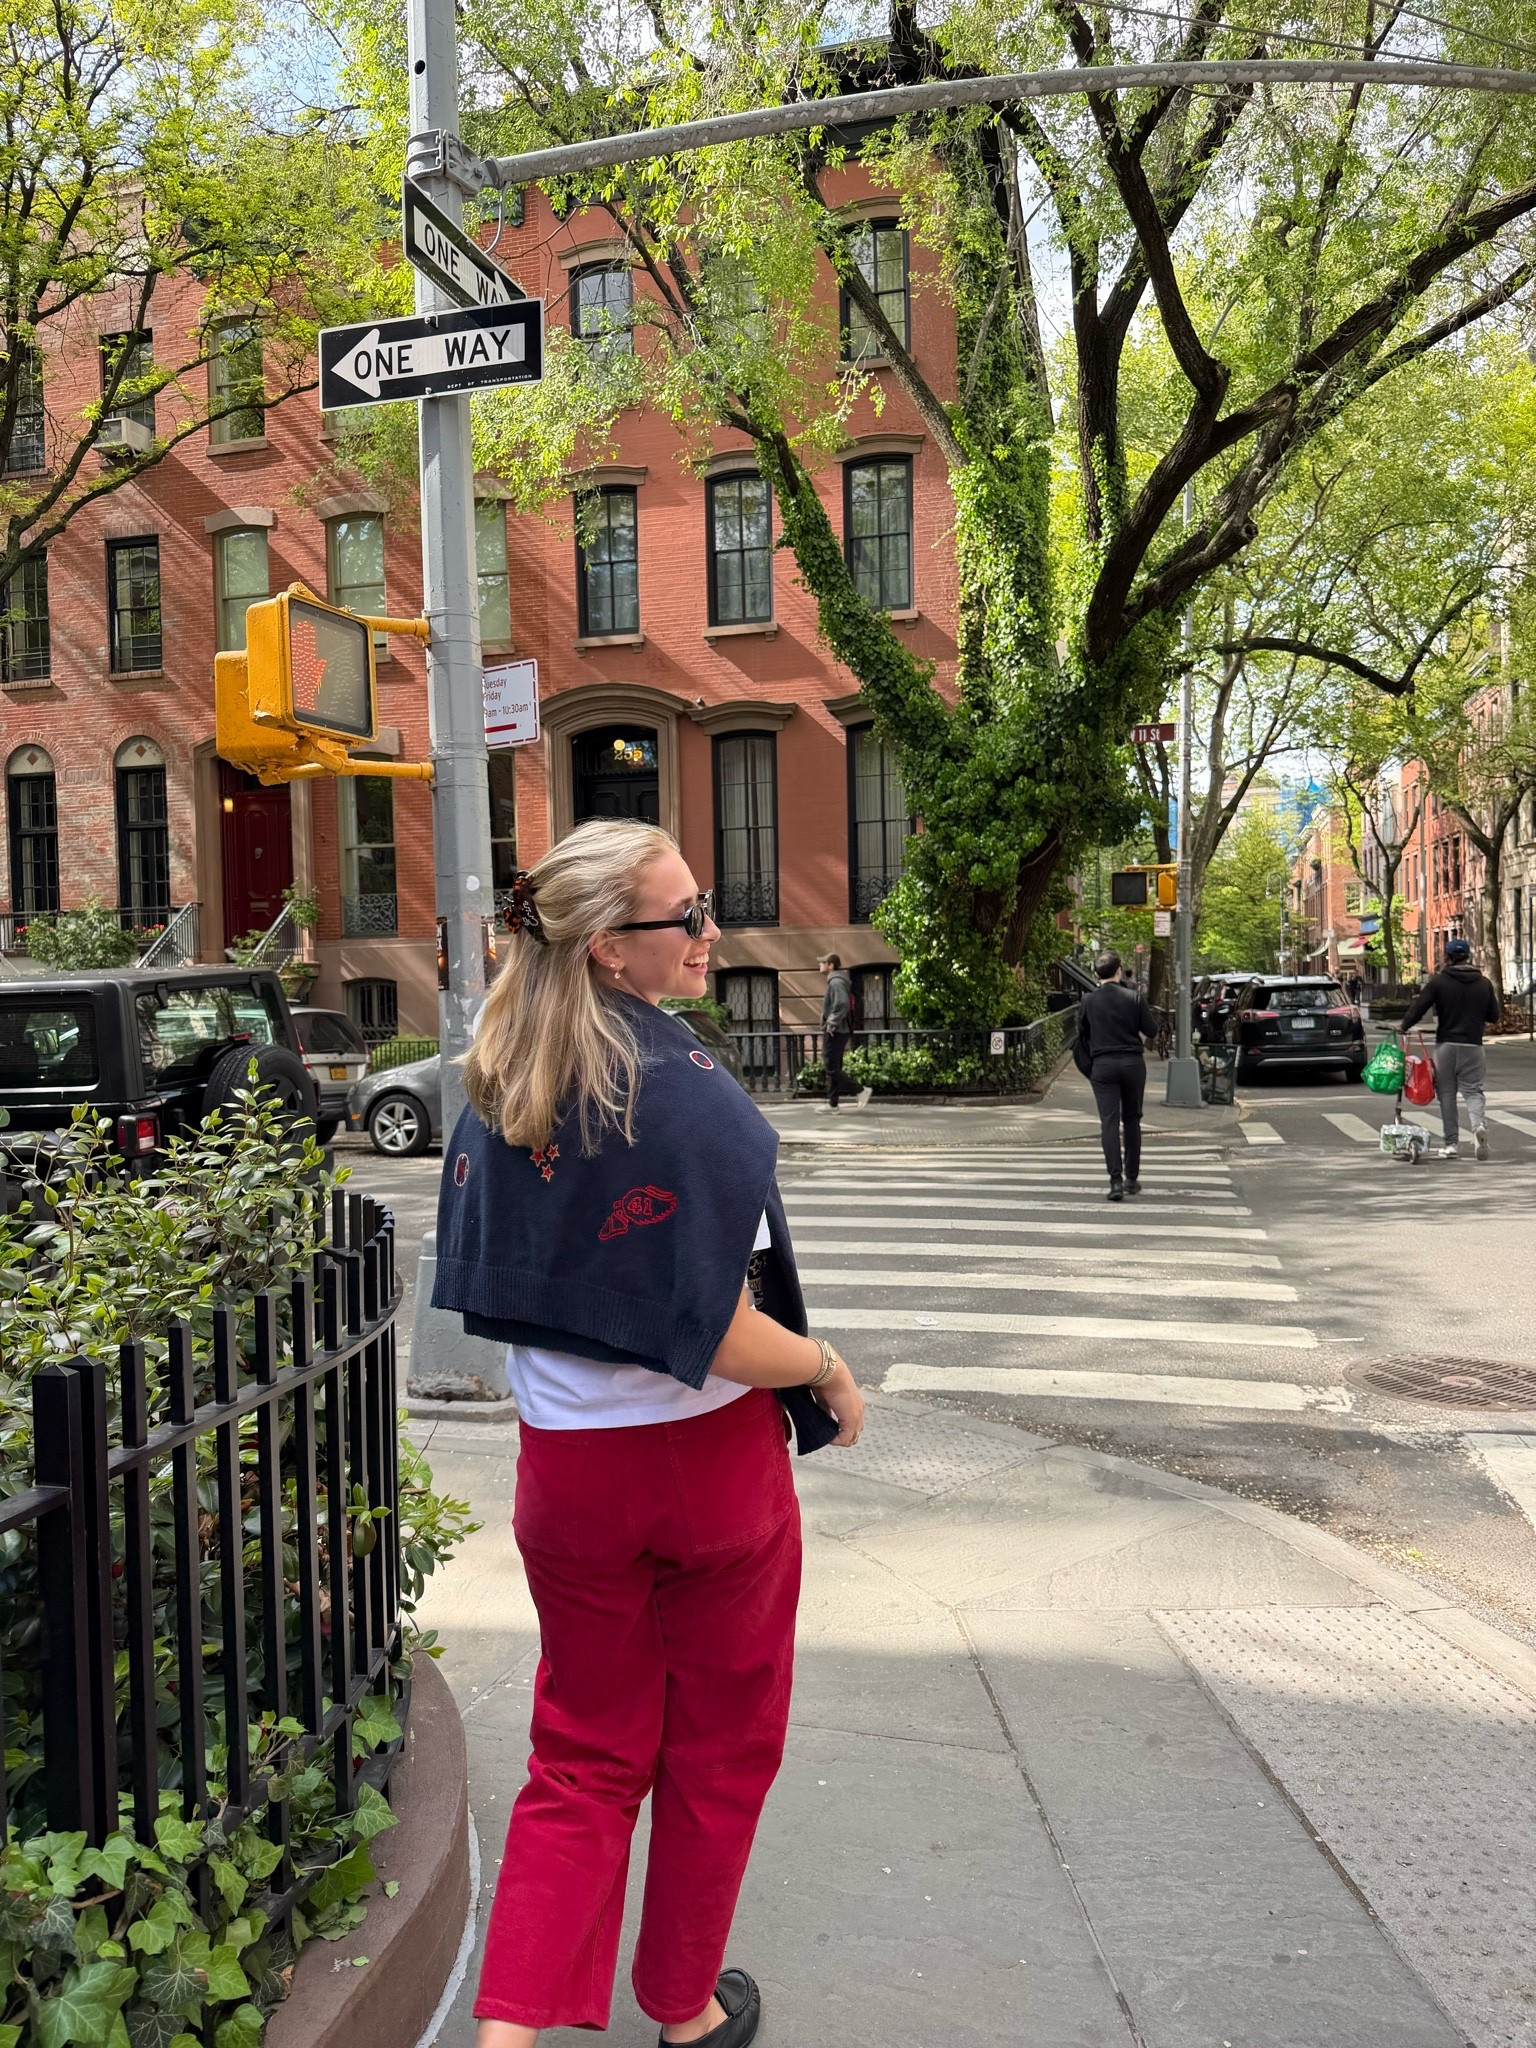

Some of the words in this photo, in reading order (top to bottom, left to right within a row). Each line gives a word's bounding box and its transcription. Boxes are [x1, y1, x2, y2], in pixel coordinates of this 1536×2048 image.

[424, 223, 460, 281] ONE
[476, 271, 504, 304] WA
[354, 344, 413, 380] ONE
[444, 329, 511, 367] WAY
[480, 374, 533, 384] TRANSPORTATION
[503, 703, 528, 715] 10:30am
[1139, 729, 1146, 741] 11
[1150, 728, 1160, 741] St
